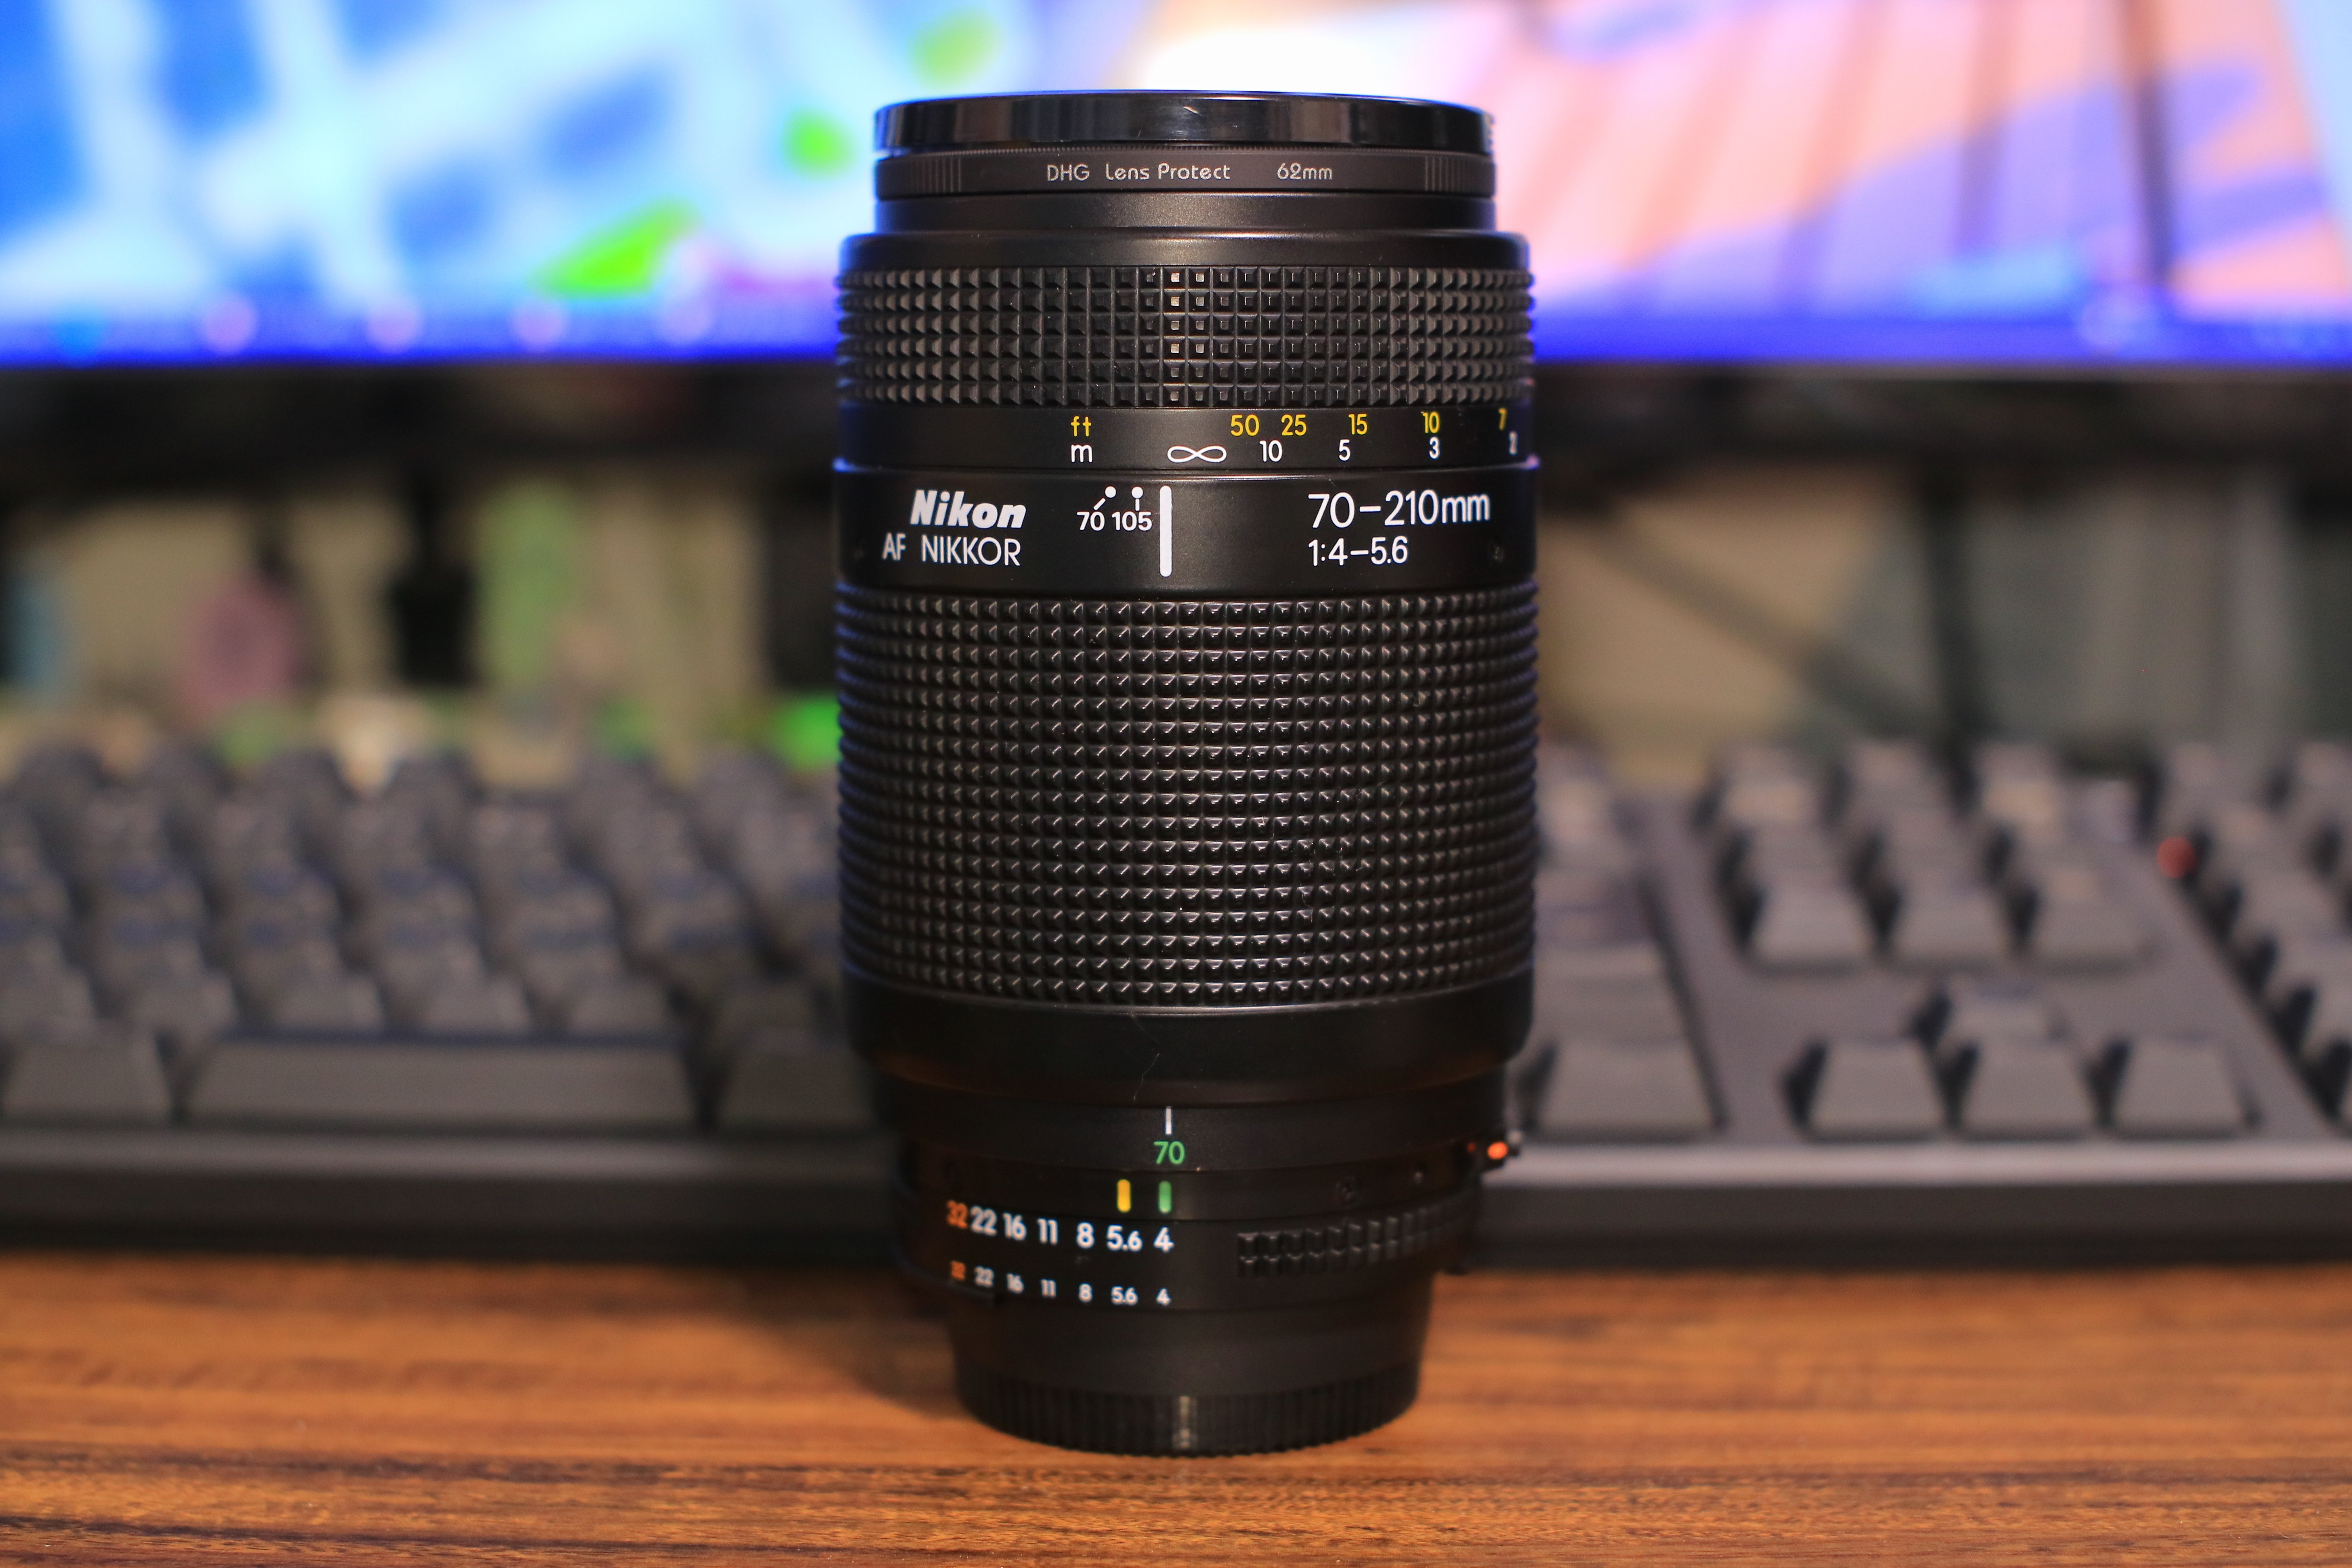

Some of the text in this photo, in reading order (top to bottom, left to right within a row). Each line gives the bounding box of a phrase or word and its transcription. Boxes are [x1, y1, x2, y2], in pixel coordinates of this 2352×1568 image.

[1047, 163, 1332, 181] DHG Lens Protect 62mm
[1071, 408, 1506, 436] ft 50 25 15 10 7
[1071, 445, 1092, 462] m
[1260, 440, 1282, 462] 10
[1339, 439, 1350, 461] 5
[1430, 437, 1439, 459] 3
[911, 490, 1026, 528] Nikon
[1077, 511, 1152, 531] 70 105
[1308, 490, 1489, 528] 70-210mm
[883, 533, 1020, 566] AF NIKKOR
[1154, 1141, 1185, 1164] 70
[948, 1201, 1173, 1251] 32 22 16 11 8 5.6 4
[975, 1267, 993, 1286] 22
[1007, 1274, 1023, 1292] 16
[1042, 1279, 1056, 1296] 11
[1080, 1283, 1092, 1301] 8
[1112, 1286, 1138, 1304] 5.6
[1157, 1289, 1170, 1305] 4
